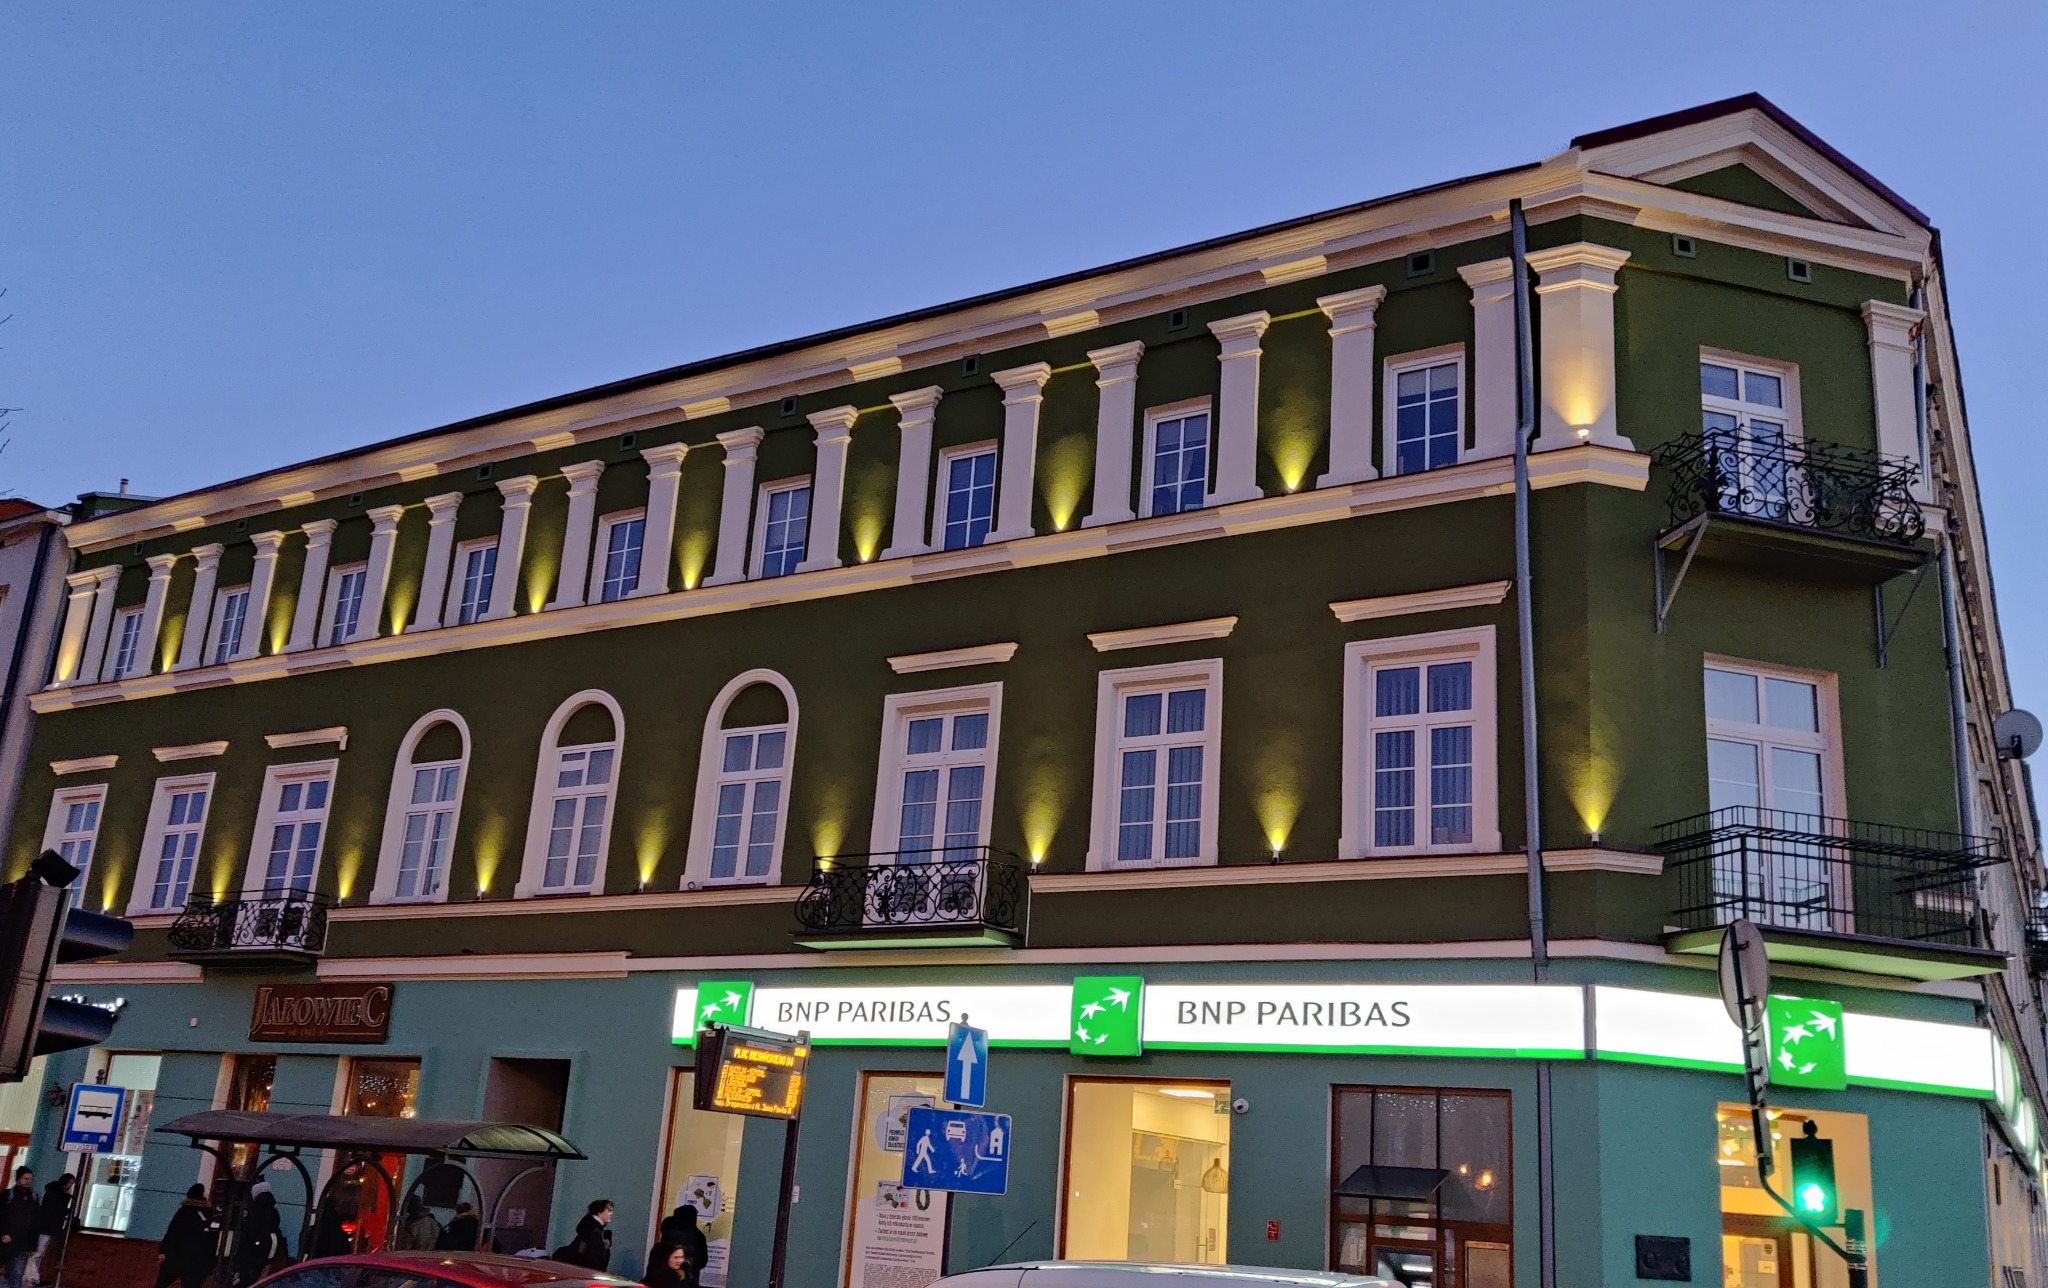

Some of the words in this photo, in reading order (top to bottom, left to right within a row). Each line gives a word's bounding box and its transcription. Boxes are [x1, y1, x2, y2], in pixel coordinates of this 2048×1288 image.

[249, 986, 388, 1034] JAŁOWIEC
[777, 1001, 830, 1023] BNP
[837, 1000, 951, 1023] PARIBAS
[1177, 1001, 1246, 1025] BNP
[1257, 1001, 1411, 1027] PARIBAS
